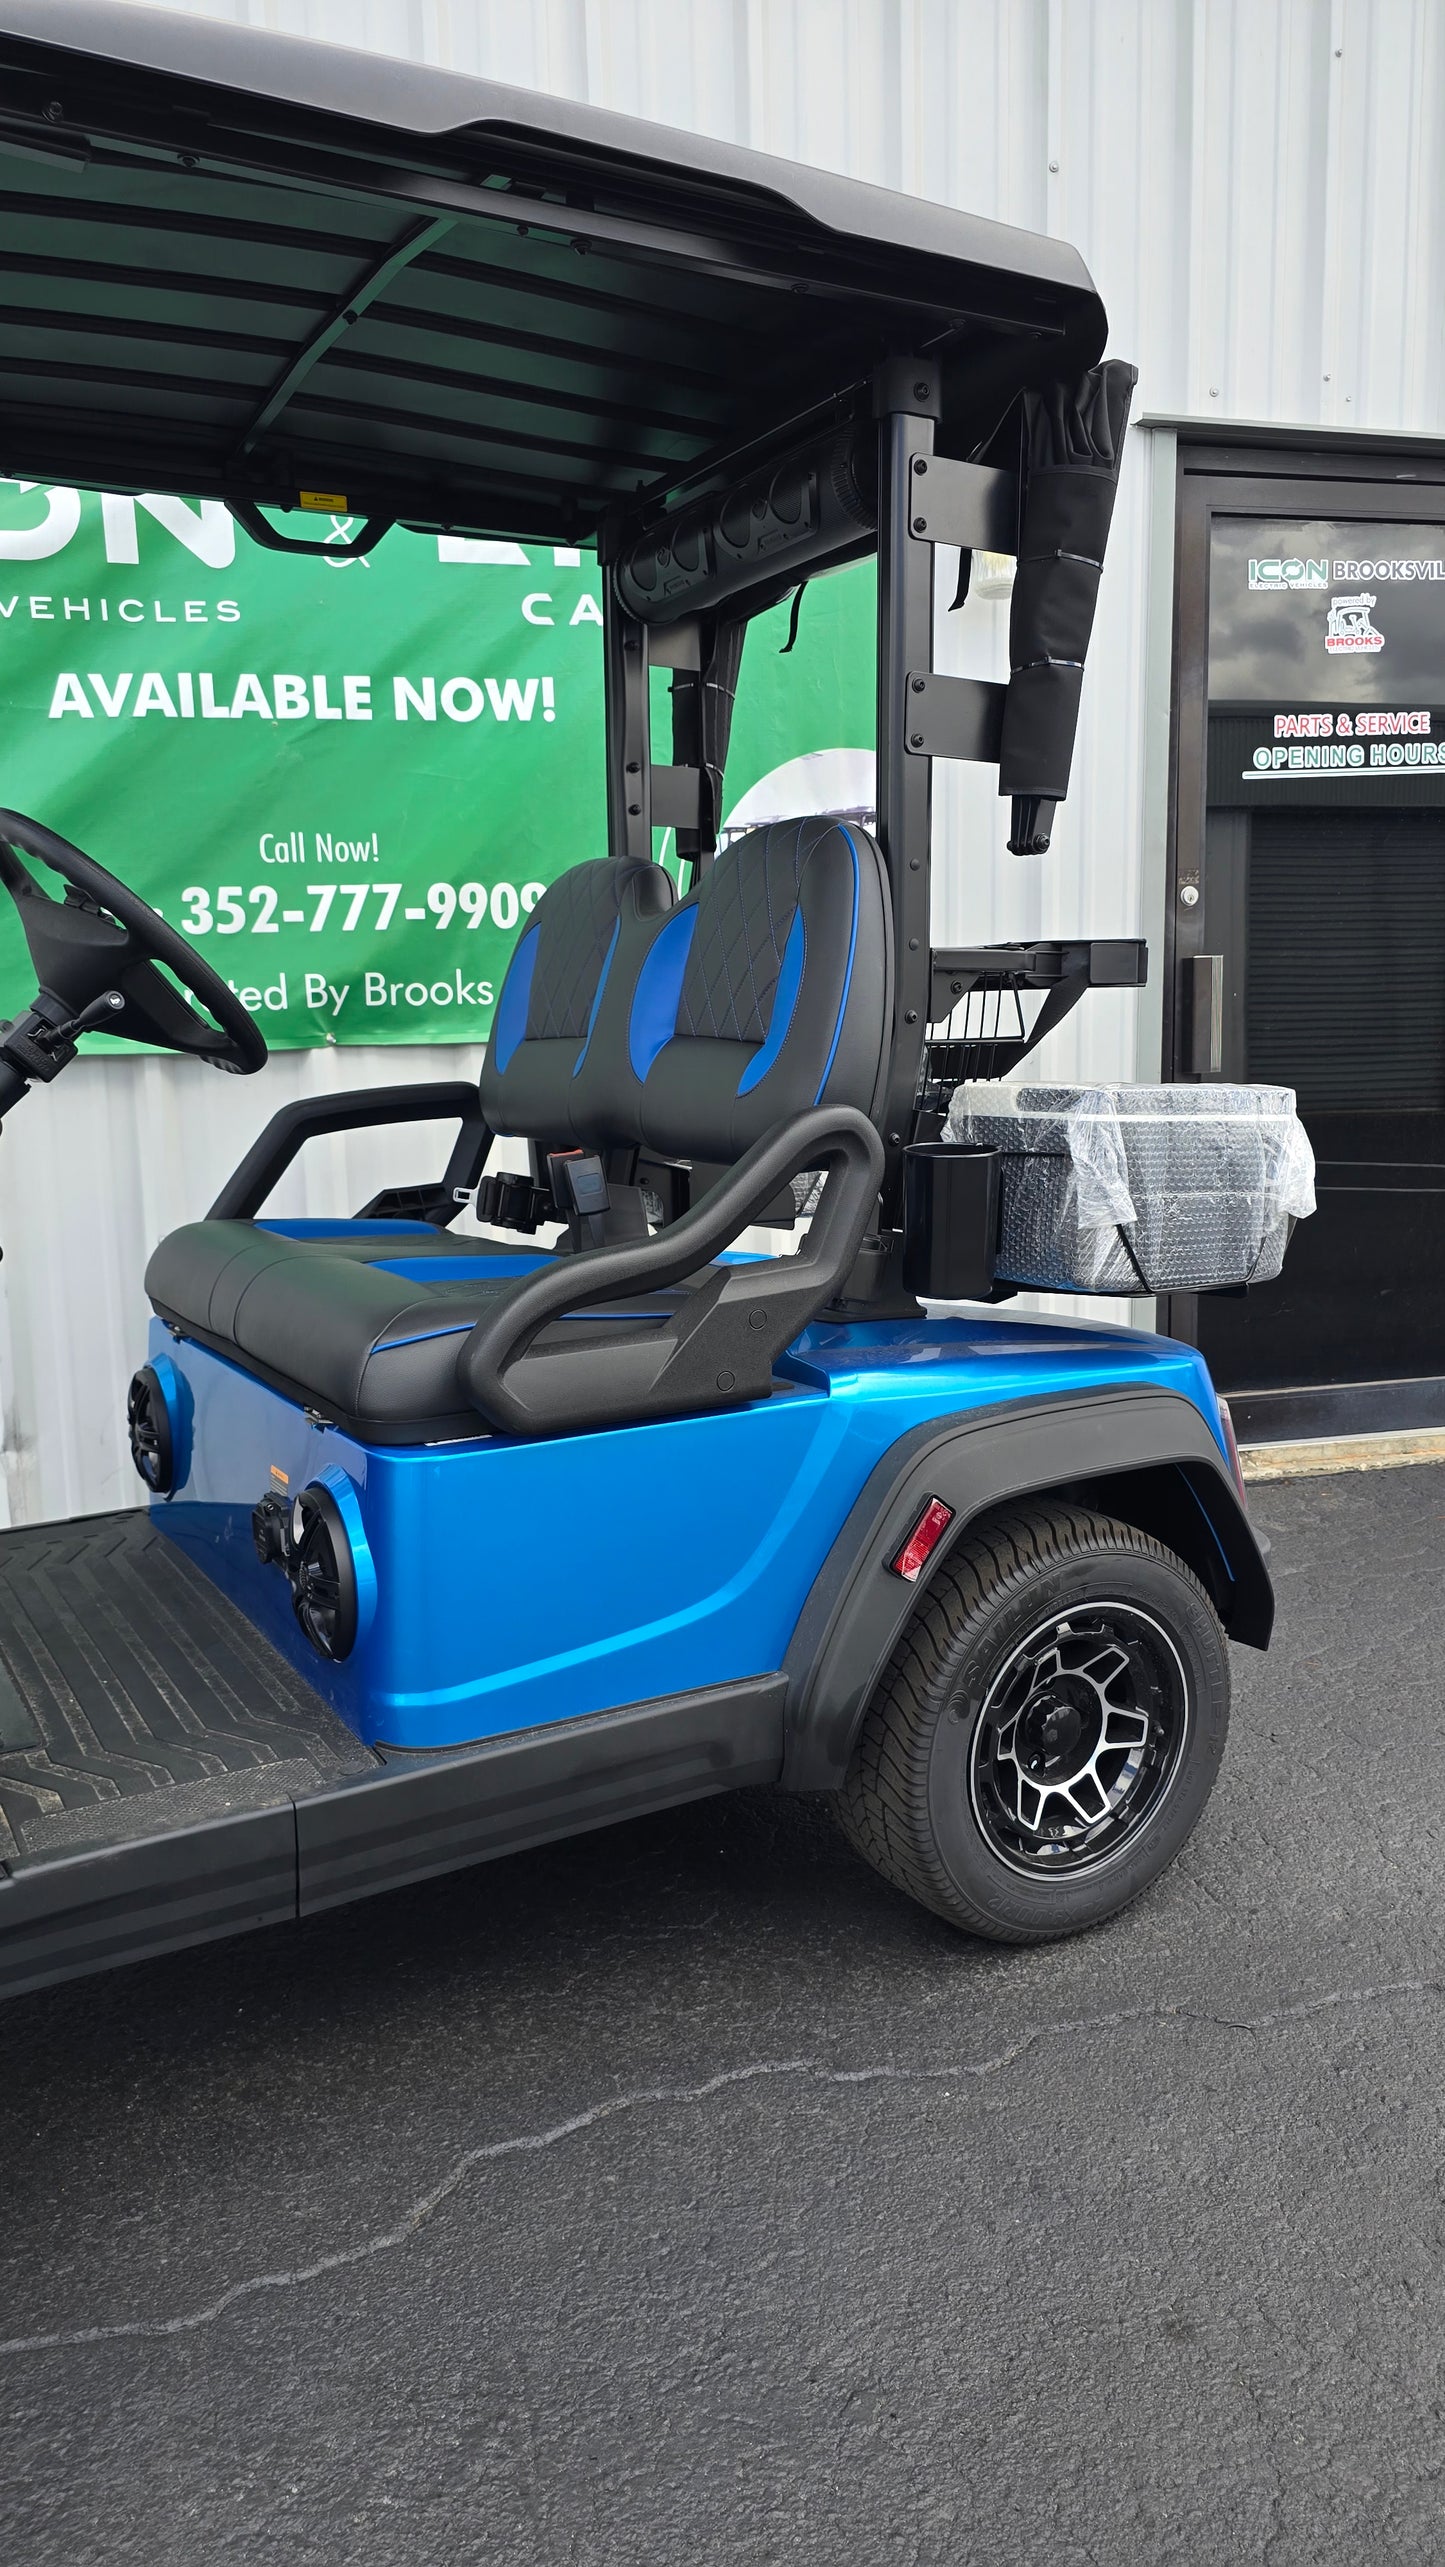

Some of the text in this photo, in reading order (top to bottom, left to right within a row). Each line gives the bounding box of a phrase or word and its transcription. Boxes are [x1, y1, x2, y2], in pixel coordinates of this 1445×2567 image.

[1249, 559, 1328, 581] ICON
[0, 595, 241, 623] VEHICLES
[1326, 636, 1383, 647] BROOKS
[48, 672, 556, 723] AVAILABLE NOW!
[1275, 713, 1429, 736] PARTS & SERVICE
[1255, 746, 1363, 768] OPENING
[259, 831, 379, 863] Call Now!
[304, 973, 350, 1016] By
[365, 968, 494, 1006] Brooks
